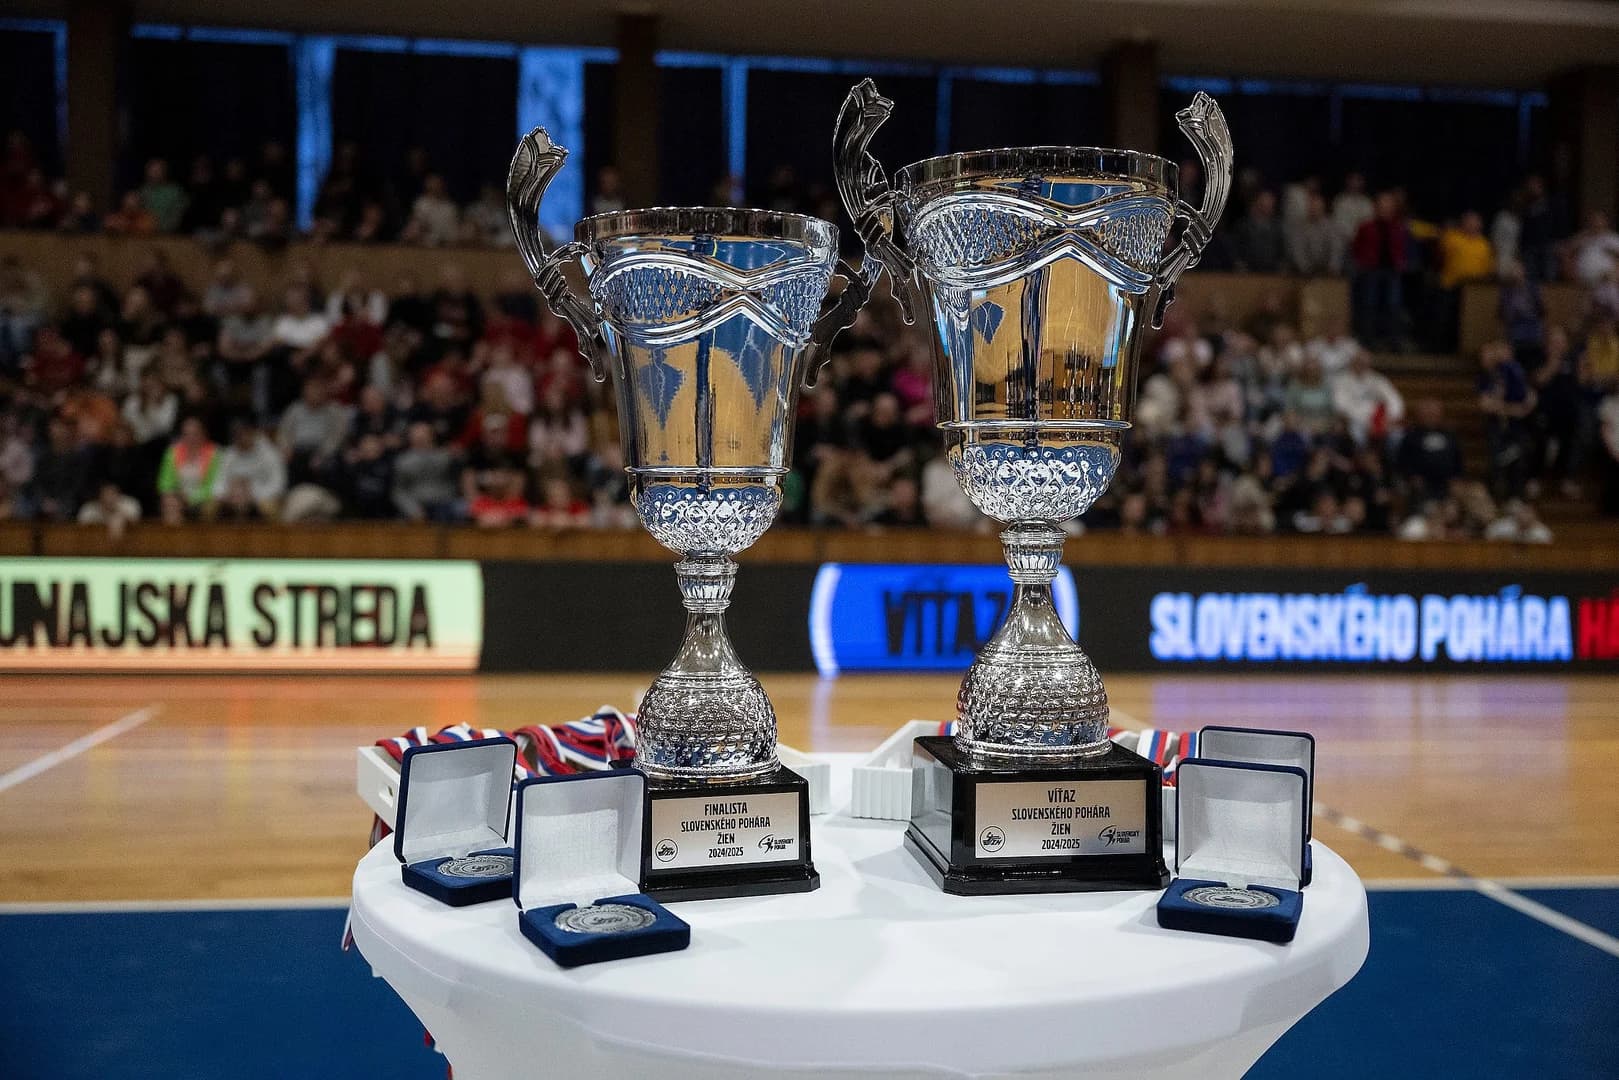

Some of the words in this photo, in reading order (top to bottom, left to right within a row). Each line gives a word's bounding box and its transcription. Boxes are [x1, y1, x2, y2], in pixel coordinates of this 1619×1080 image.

[250, 583, 432, 648] STREDA
[1149, 583, 1417, 661] SLOVENSKÉHO
[1420, 584, 1573, 661] POHÁRA
[1048, 788, 1076, 803] VÍŤAZ
[704, 802, 748, 816] FINALISTA
[1012, 805, 1073, 820] SLOVENSKÉHO
[1075, 804, 1110, 819] POHÁRA
[681, 818, 736, 833] SLOVENSKÉHO
[739, 816, 771, 829] POHÁRA
[1051, 821, 1071, 835] ŽIEN
[717, 833, 735, 845] ŽIEN
[1042, 838, 1080, 850] 2024/2025
[709, 846, 744, 858] 2024/2025
